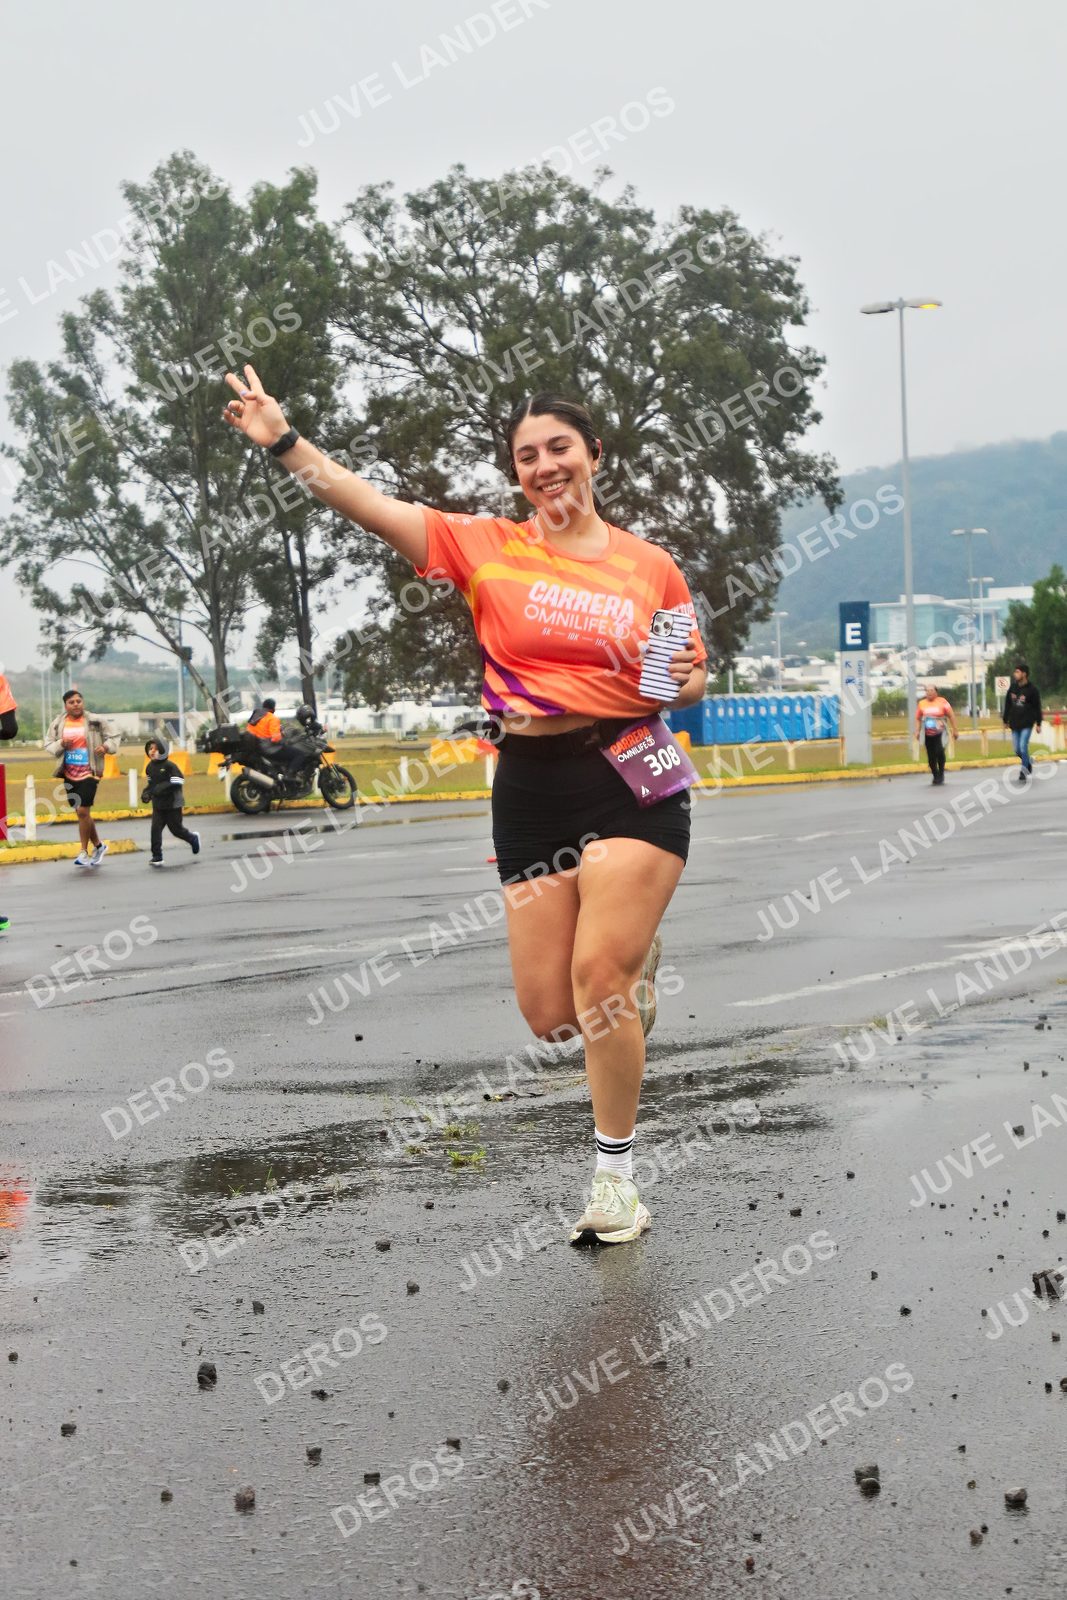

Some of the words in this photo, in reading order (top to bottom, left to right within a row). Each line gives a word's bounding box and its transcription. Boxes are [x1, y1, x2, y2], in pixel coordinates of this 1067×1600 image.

[528, 579, 635, 621] CARRERA
[845, 622, 862, 645] E
[609, 726, 651, 756] CARRERA
[643, 744, 681, 777] 308
